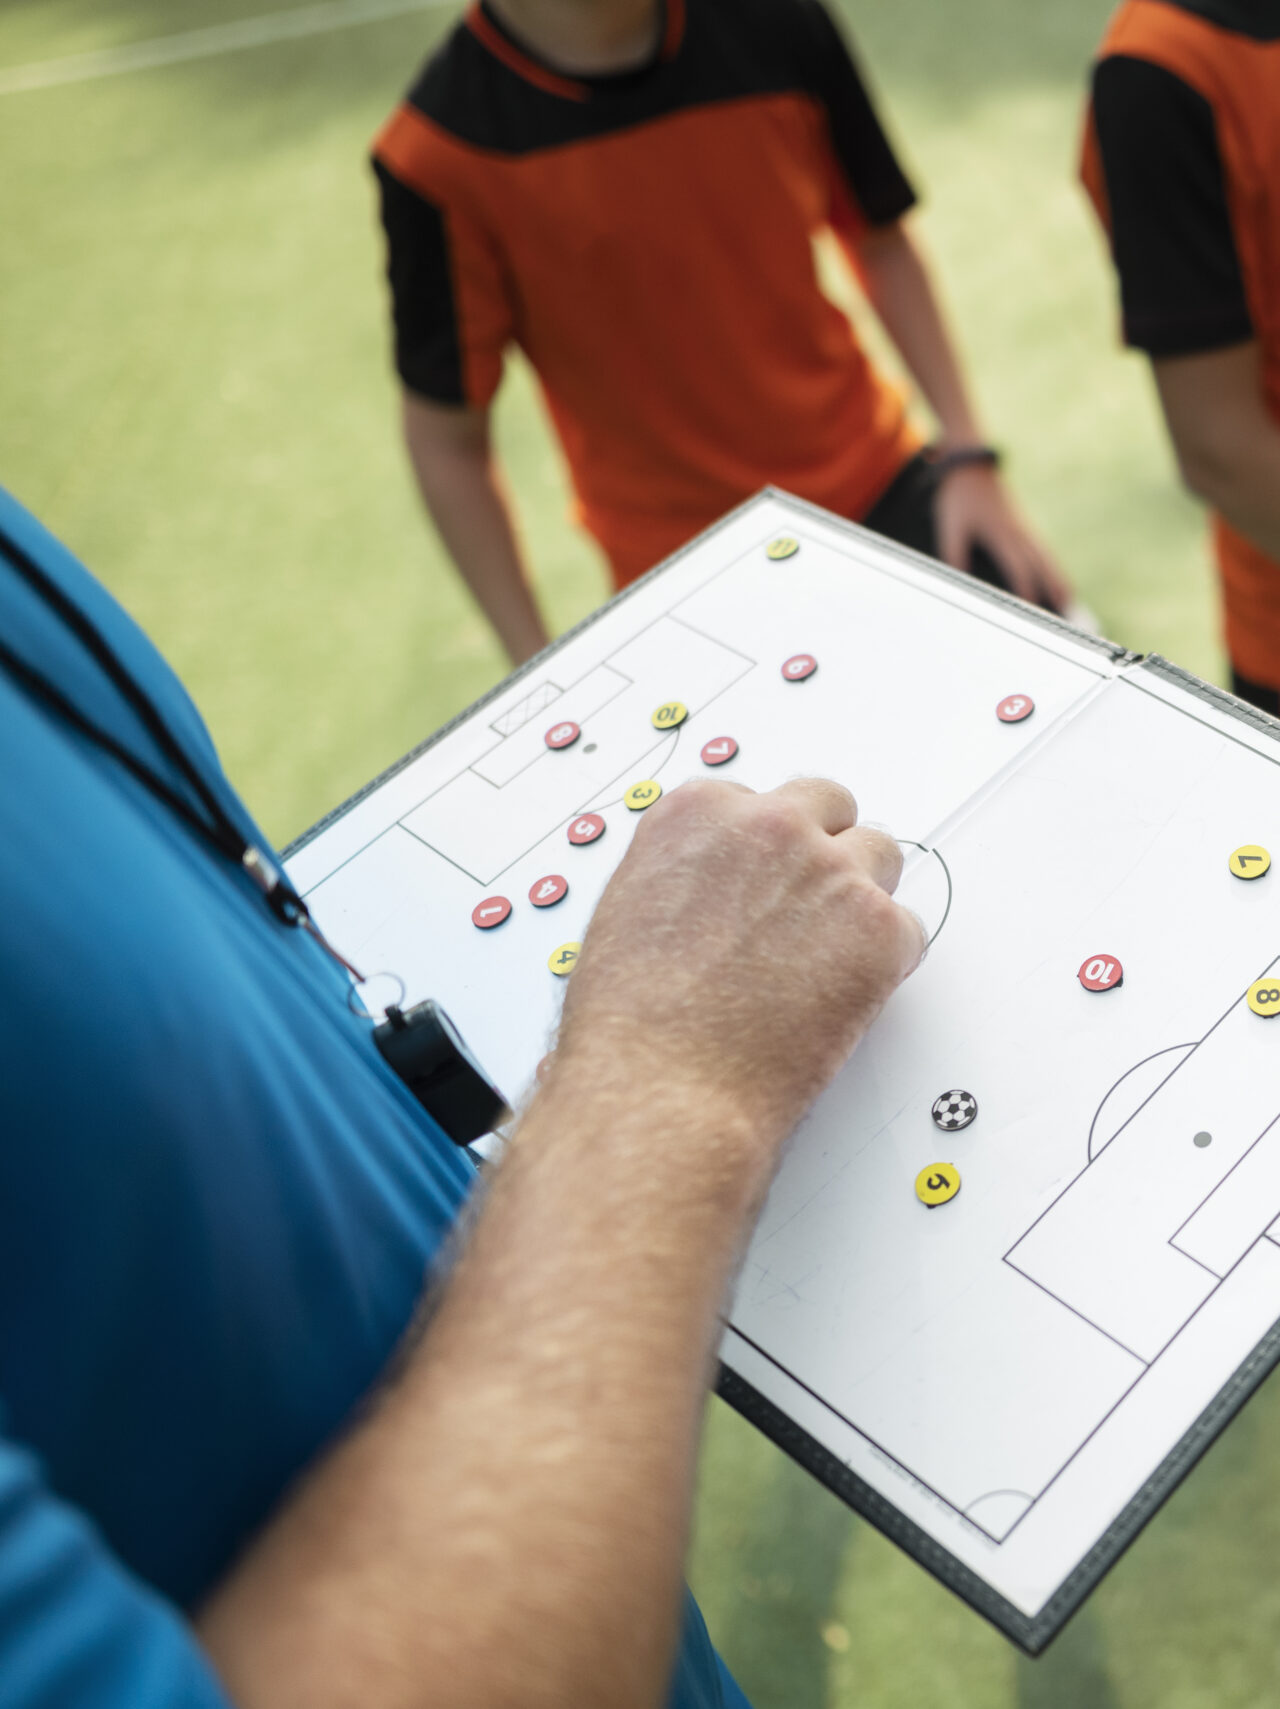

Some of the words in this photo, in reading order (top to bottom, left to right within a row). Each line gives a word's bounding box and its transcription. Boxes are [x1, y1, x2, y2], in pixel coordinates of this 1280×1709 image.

[657, 707, 676, 720] 10
[1004, 698, 1026, 716] 3
[551, 725, 573, 743] 8
[707, 742, 728, 754] 7
[633, 788, 652, 799] 3
[575, 821, 596, 836] 5
[1238, 855, 1262, 868] 7
[537, 880, 558, 898] 4
[557, 950, 576, 964] 4
[1085, 960, 1114, 984] 10
[1256, 989, 1280, 1004] 8
